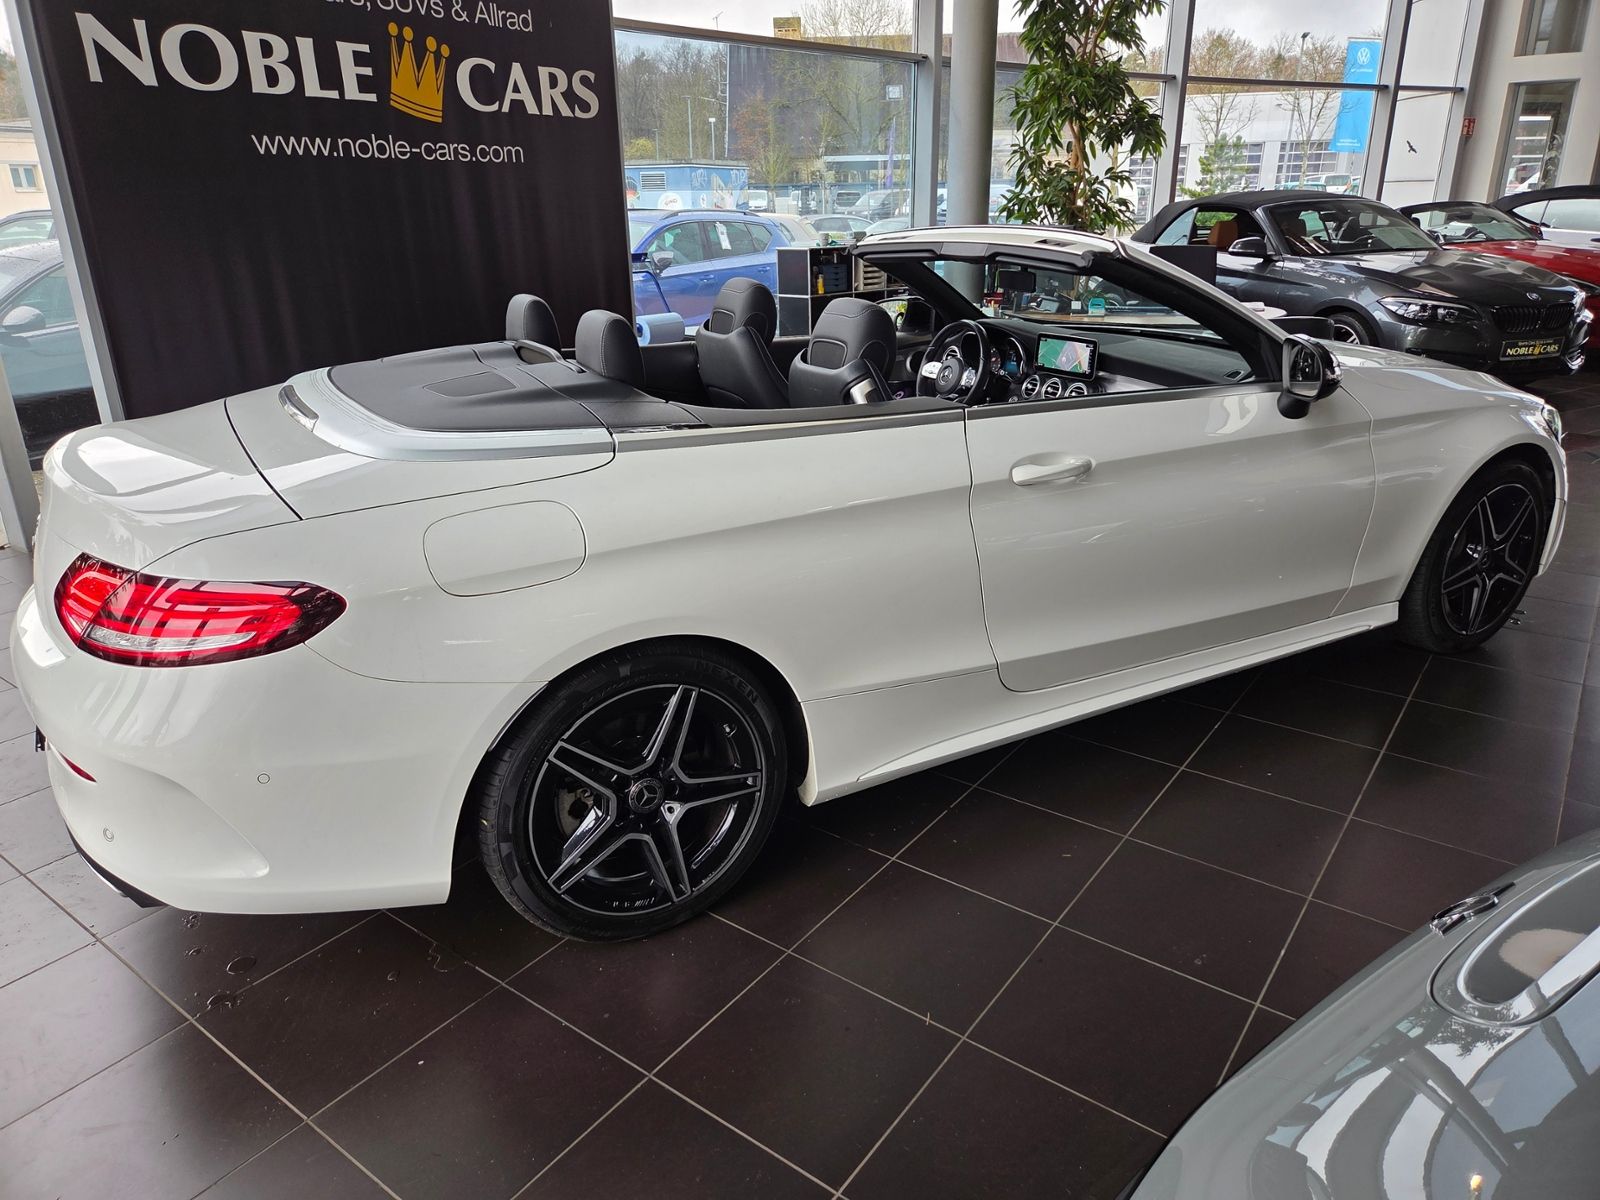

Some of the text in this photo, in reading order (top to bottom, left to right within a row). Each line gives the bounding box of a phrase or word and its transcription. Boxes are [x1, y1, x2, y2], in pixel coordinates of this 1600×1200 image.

[451, 0, 470, 23] &
[474, 1, 533, 33] Allrad
[74, 11, 600, 119] NOBLE CARS
[251, 133, 524, 163] www.noble-cars.com
[1505, 344, 1559, 356] NOBLE CARS
